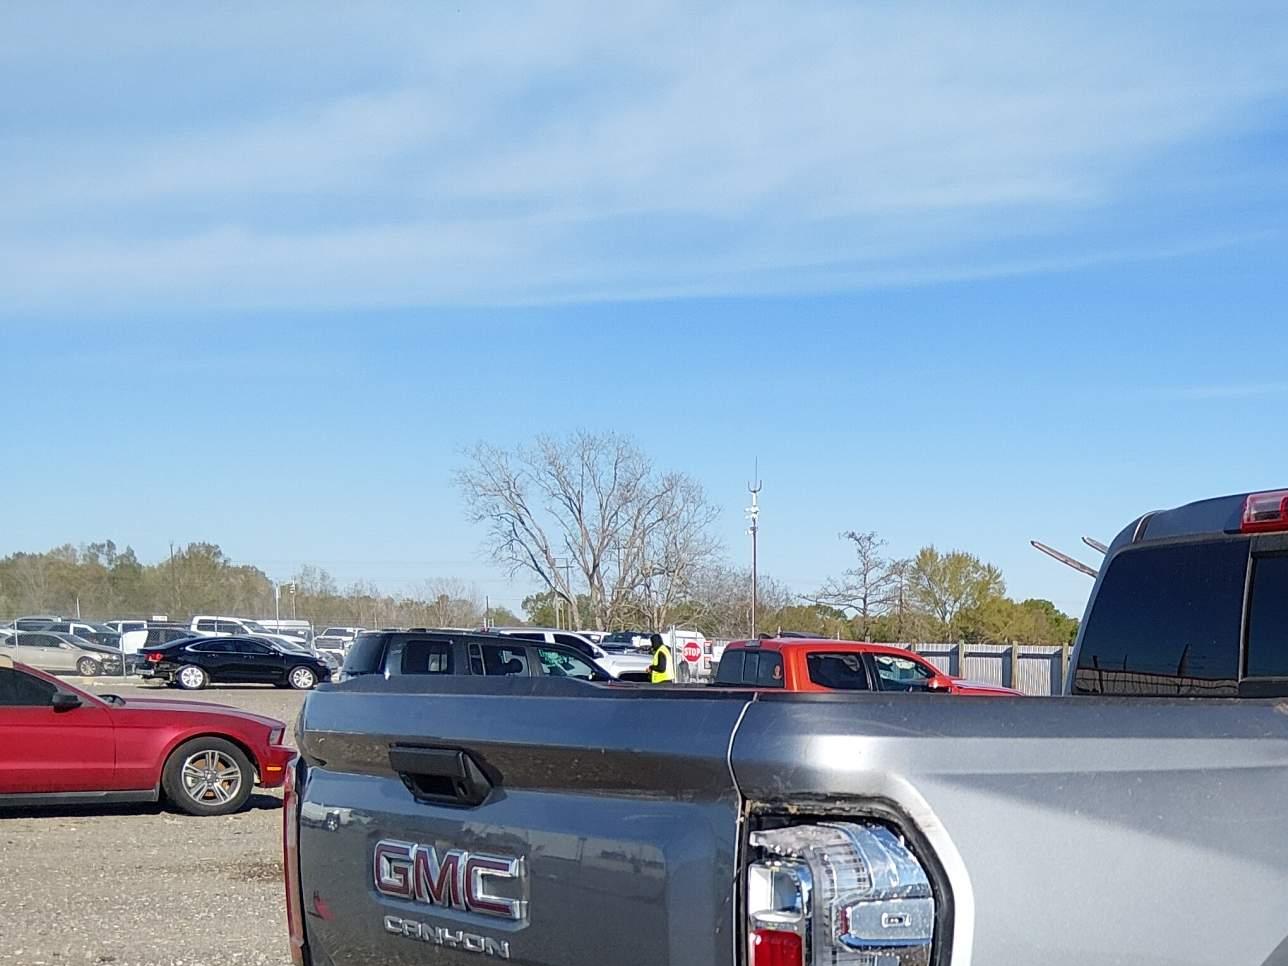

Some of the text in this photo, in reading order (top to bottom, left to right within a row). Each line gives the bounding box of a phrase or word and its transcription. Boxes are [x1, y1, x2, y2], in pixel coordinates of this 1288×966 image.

[684, 647, 701, 657] STOP
[374, 839, 523, 919] GMC
[384, 915, 510, 960] CANYON
